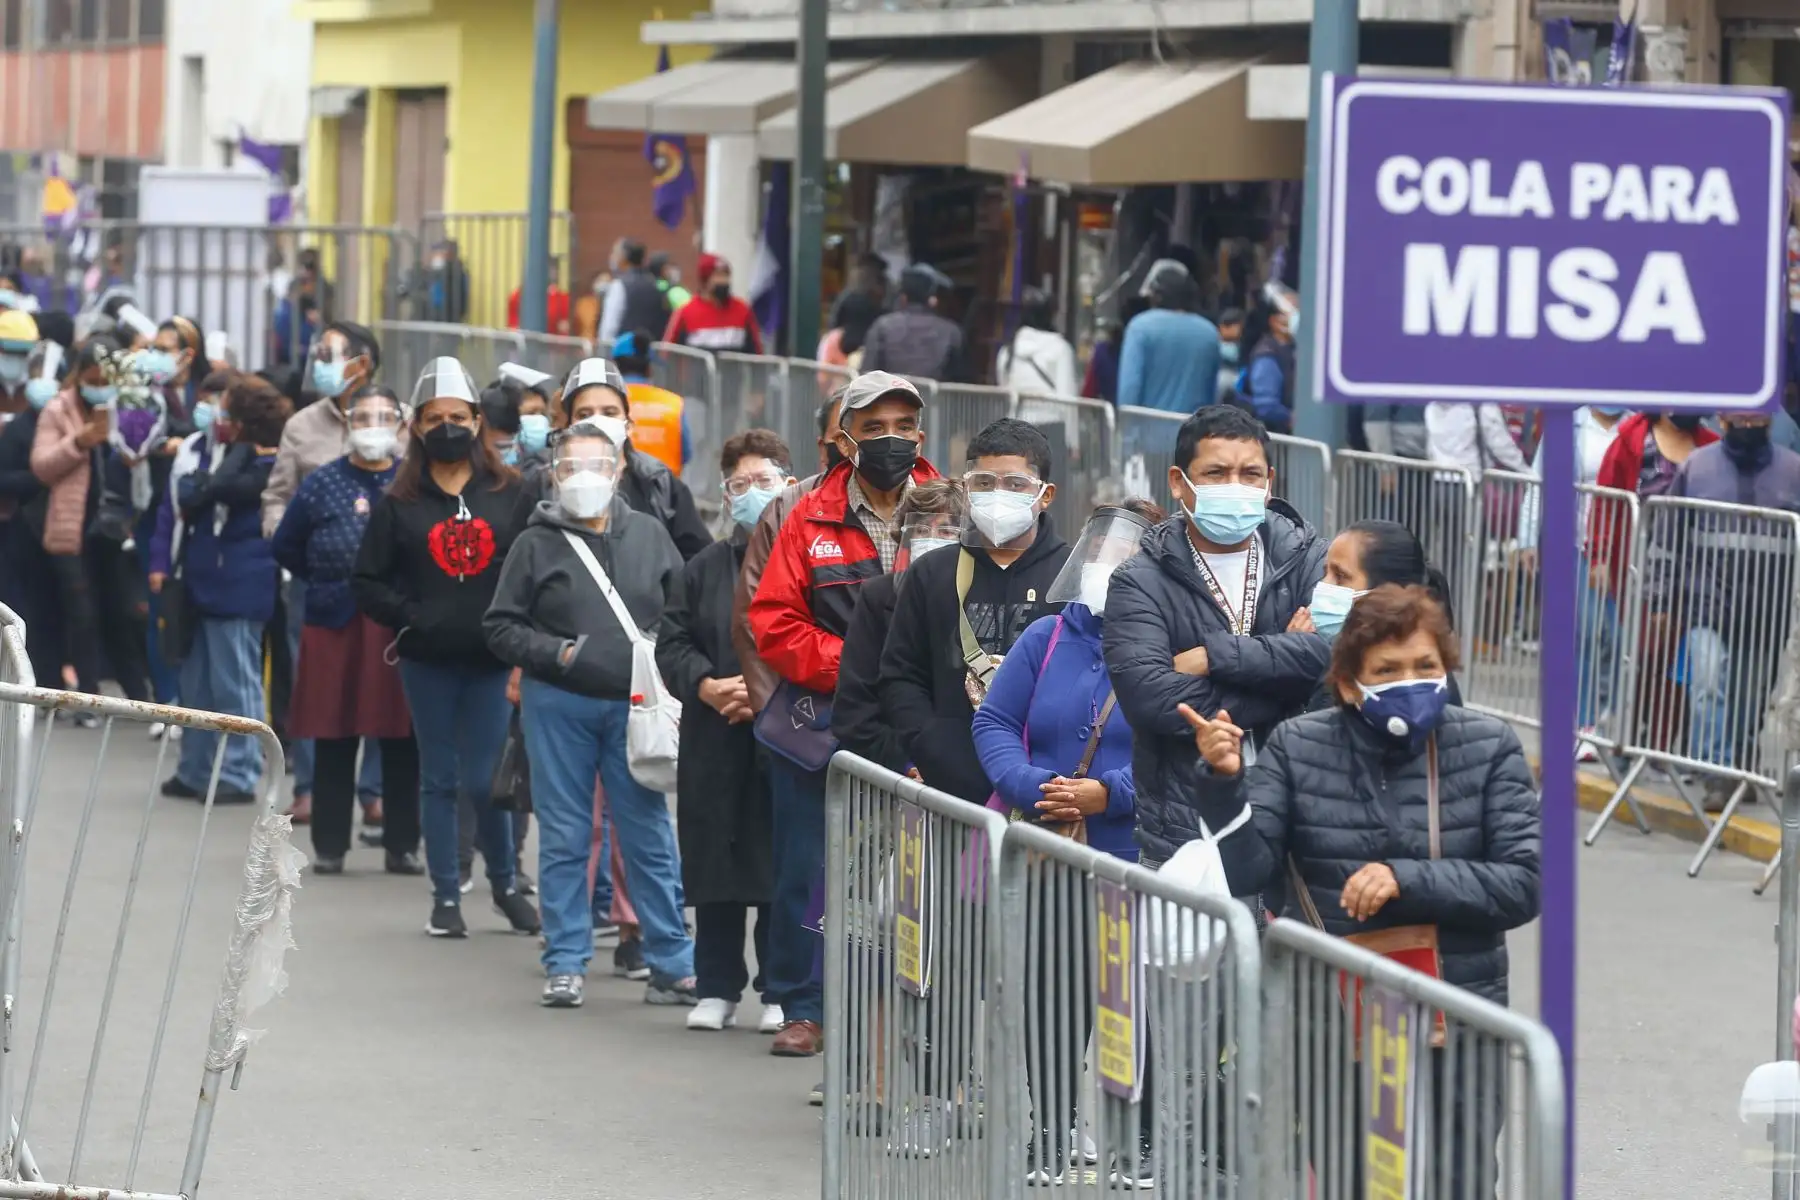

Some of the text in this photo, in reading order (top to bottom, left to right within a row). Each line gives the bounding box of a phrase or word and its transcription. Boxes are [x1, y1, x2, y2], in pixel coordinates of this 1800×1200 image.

[1376, 155, 1740, 226] COLA PARA
[1402, 243, 1706, 344] MISA
